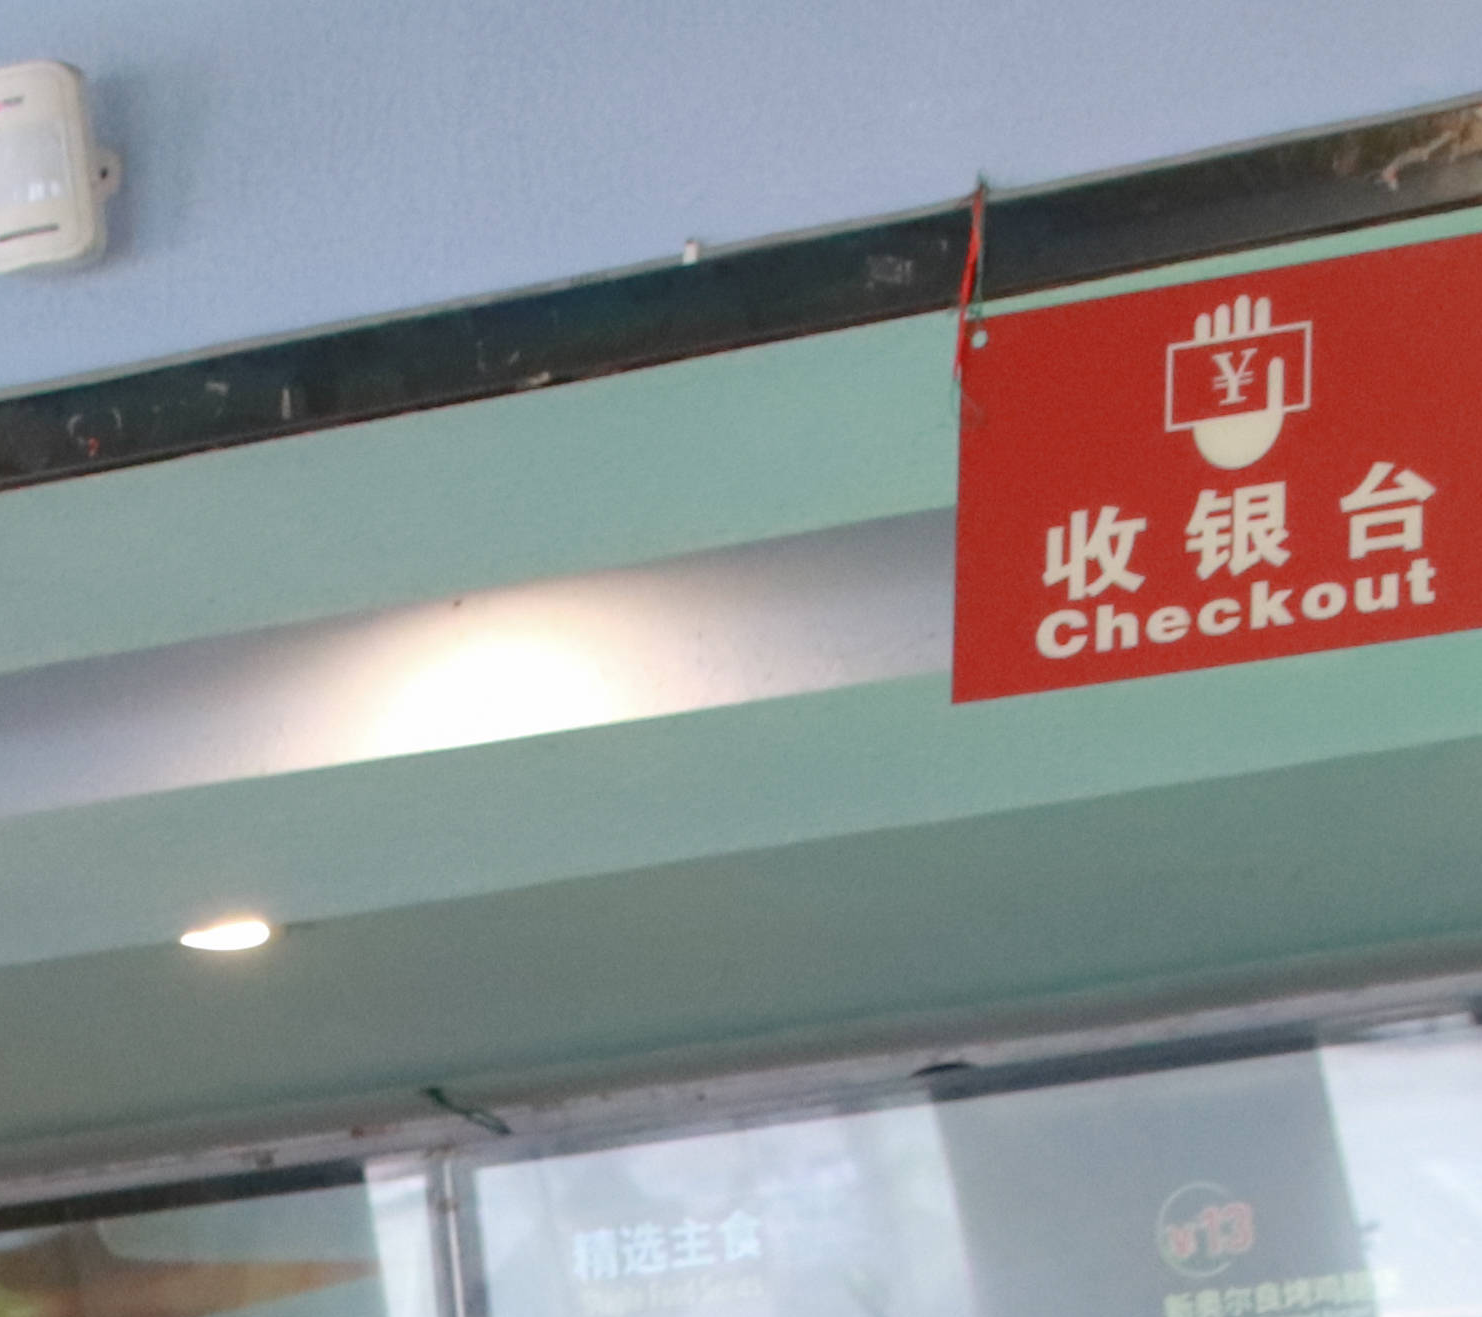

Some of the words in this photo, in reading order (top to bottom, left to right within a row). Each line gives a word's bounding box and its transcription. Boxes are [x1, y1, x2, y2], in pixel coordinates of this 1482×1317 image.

[1042, 462, 1436, 602] 收银台
[1035, 566, 1436, 660] Checkout
[572, 1208, 762, 1281] 精选主食
